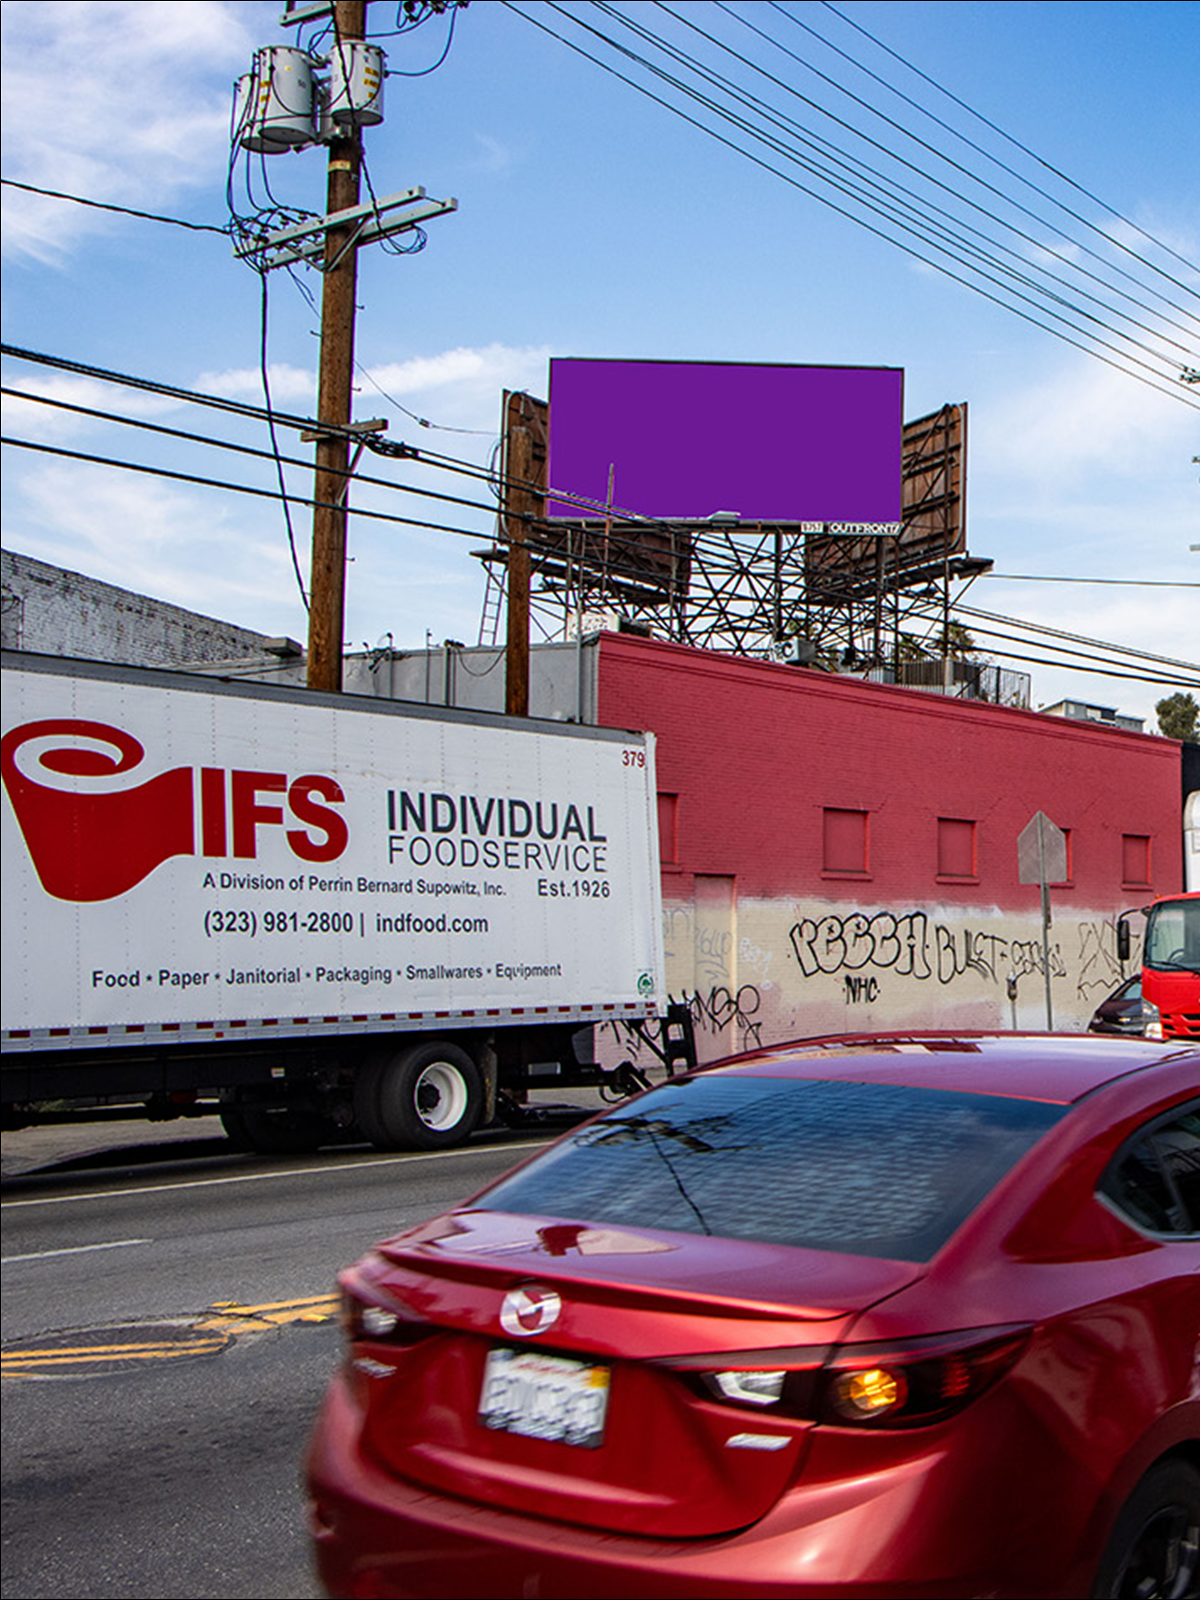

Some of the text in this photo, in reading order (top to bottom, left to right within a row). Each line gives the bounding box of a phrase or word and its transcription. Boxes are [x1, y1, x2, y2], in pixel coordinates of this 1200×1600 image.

[622, 750, 645, 768] 379
[200, 766, 348, 863] IFS
[386, 789, 608, 843] INDIVIDUAL
[387, 834, 608, 873] FOODSERVICE
[203, 872, 508, 897] A Division of Perrin Bernard Supowitz, Inc.
[537, 878, 611, 898] Est.1926
[203, 910, 489, 938] (323) 981-2800 indfood.com
[92, 963, 562, 989] Food Paper Janitorial Packaging Smallwares Equipment
